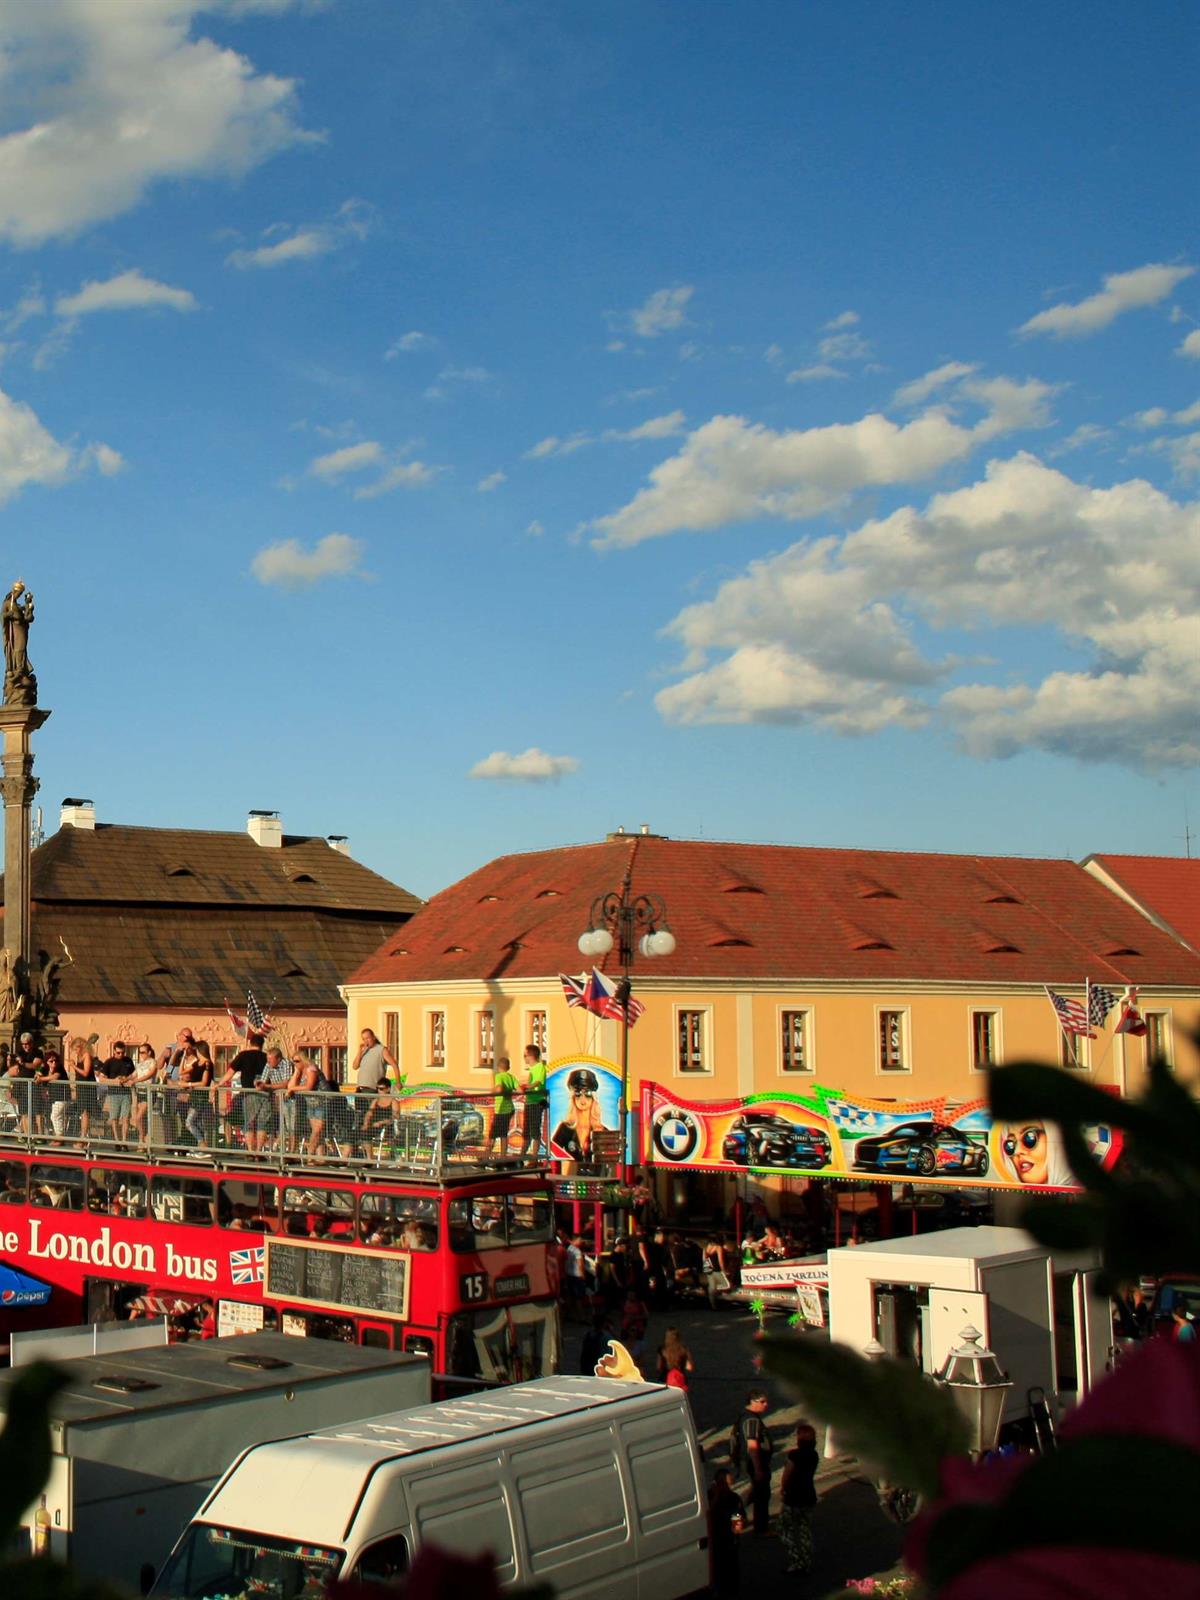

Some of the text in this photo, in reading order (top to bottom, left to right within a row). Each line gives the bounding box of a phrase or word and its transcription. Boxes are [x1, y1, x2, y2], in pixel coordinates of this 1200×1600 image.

[657, 1110, 694, 1127] BMW
[28, 1219, 156, 1273] London
[167, 1243, 218, 1281] bus
[744, 1270, 829, 1282] TOČENÁ ZMRZLIN
[465, 1275, 483, 1298] 15
[16, 1291, 45, 1303] pepsi
